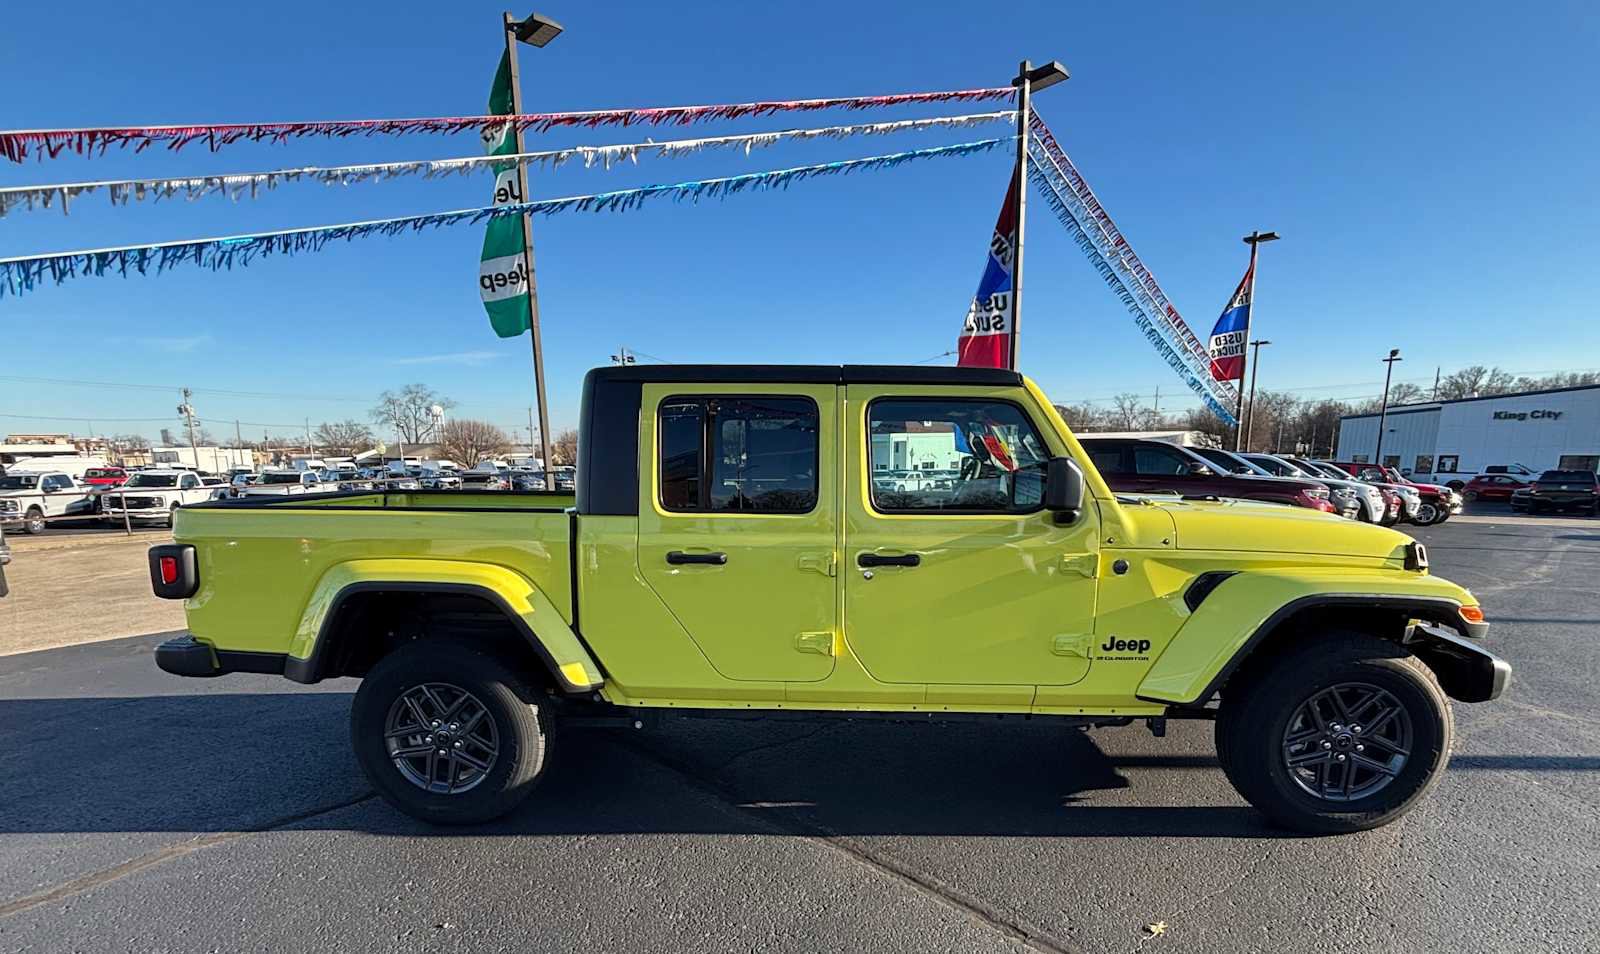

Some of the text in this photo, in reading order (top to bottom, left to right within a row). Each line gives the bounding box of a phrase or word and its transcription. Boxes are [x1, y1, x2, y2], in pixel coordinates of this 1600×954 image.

[1493, 409, 1564, 421] King City
[1102, 635, 1151, 654] Jeep
